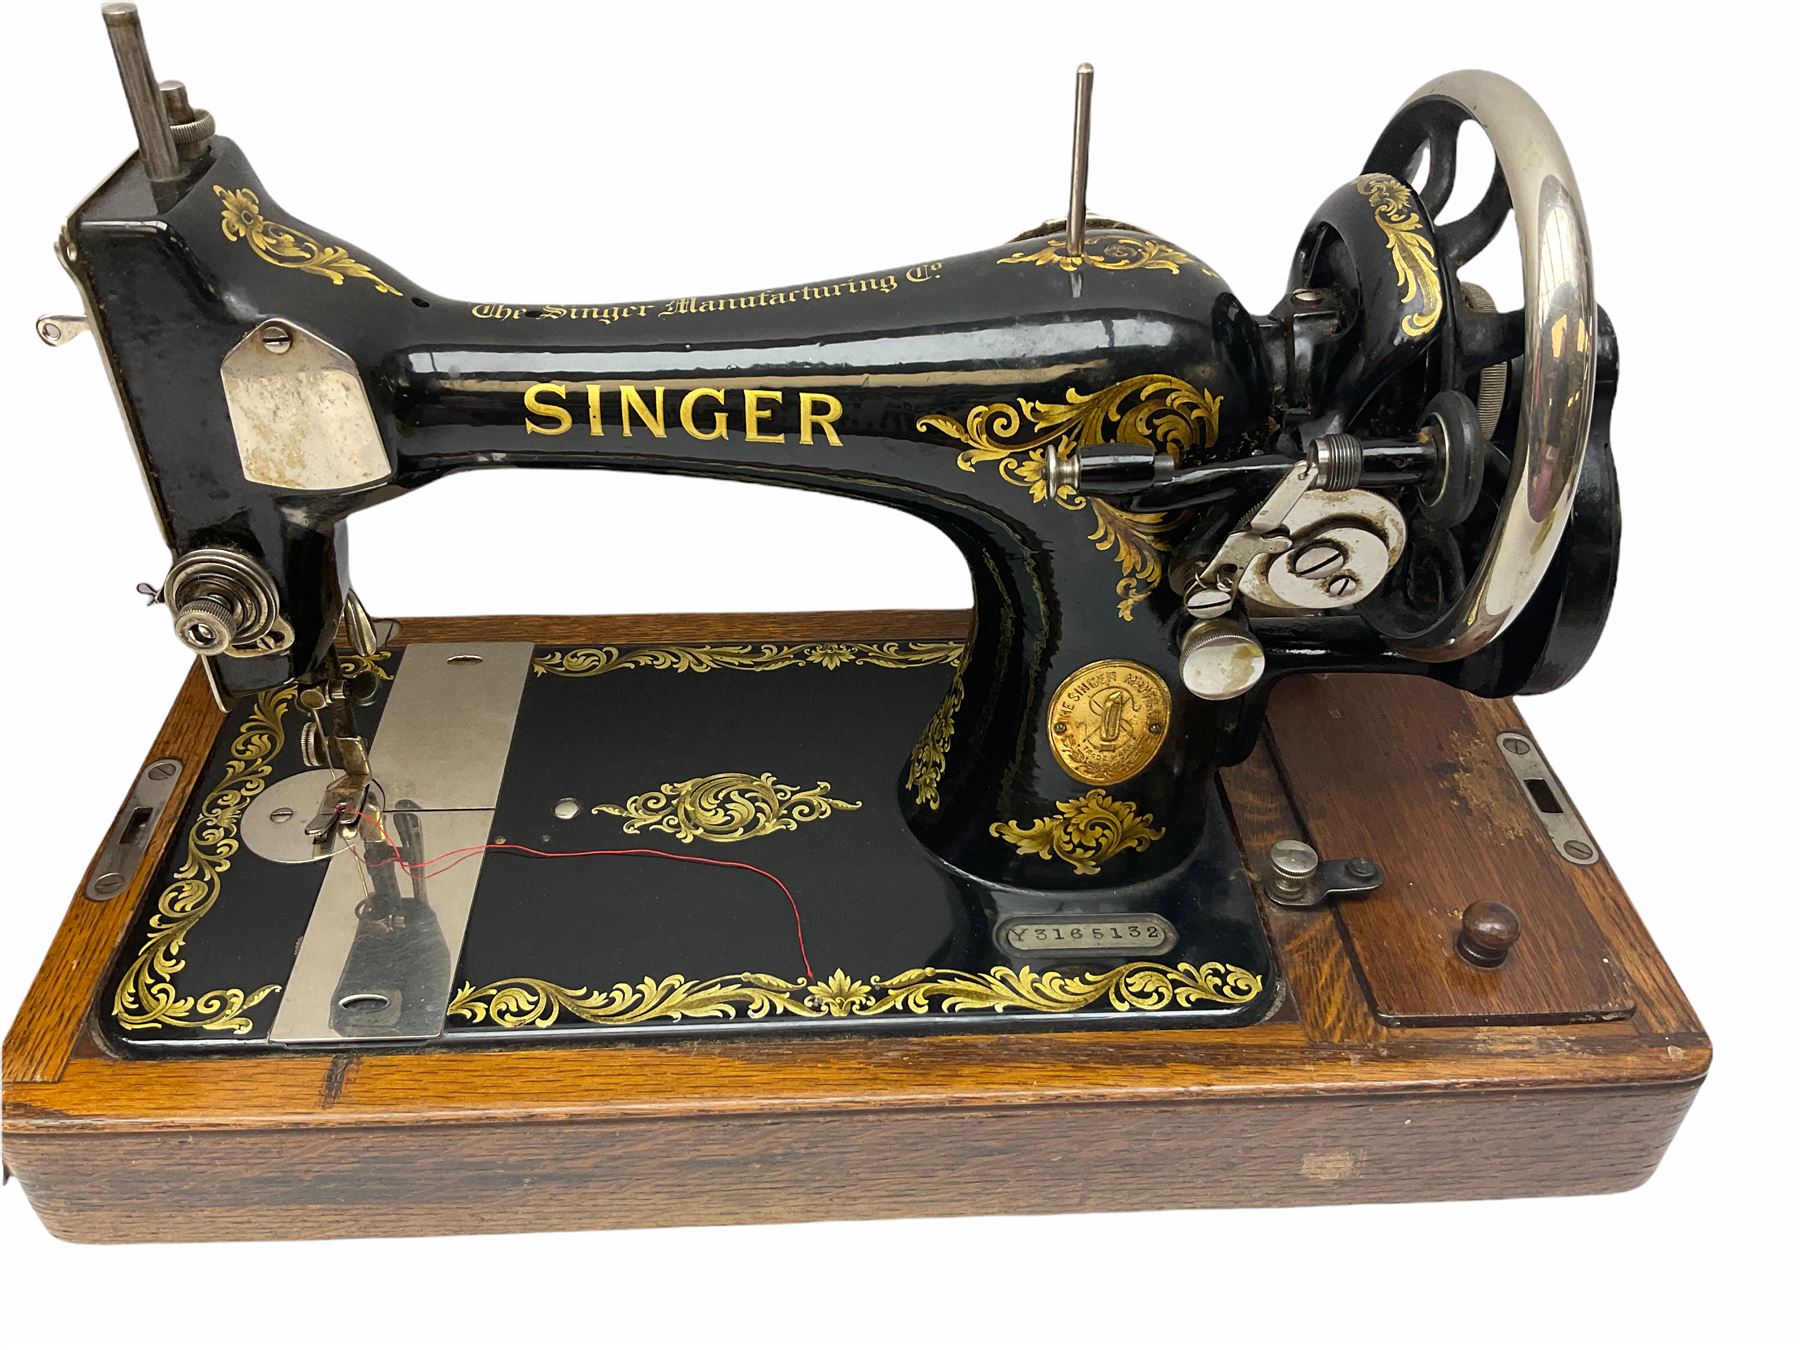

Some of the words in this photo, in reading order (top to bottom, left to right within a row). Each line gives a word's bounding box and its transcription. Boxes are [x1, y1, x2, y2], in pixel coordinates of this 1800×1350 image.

[471, 304, 527, 321] The
[534, 304, 654, 325] Singer
[657, 275, 898, 318] Manufacturing
[524, 383, 843, 447] SINGER
[1067, 671, 1117, 702] SINGER
